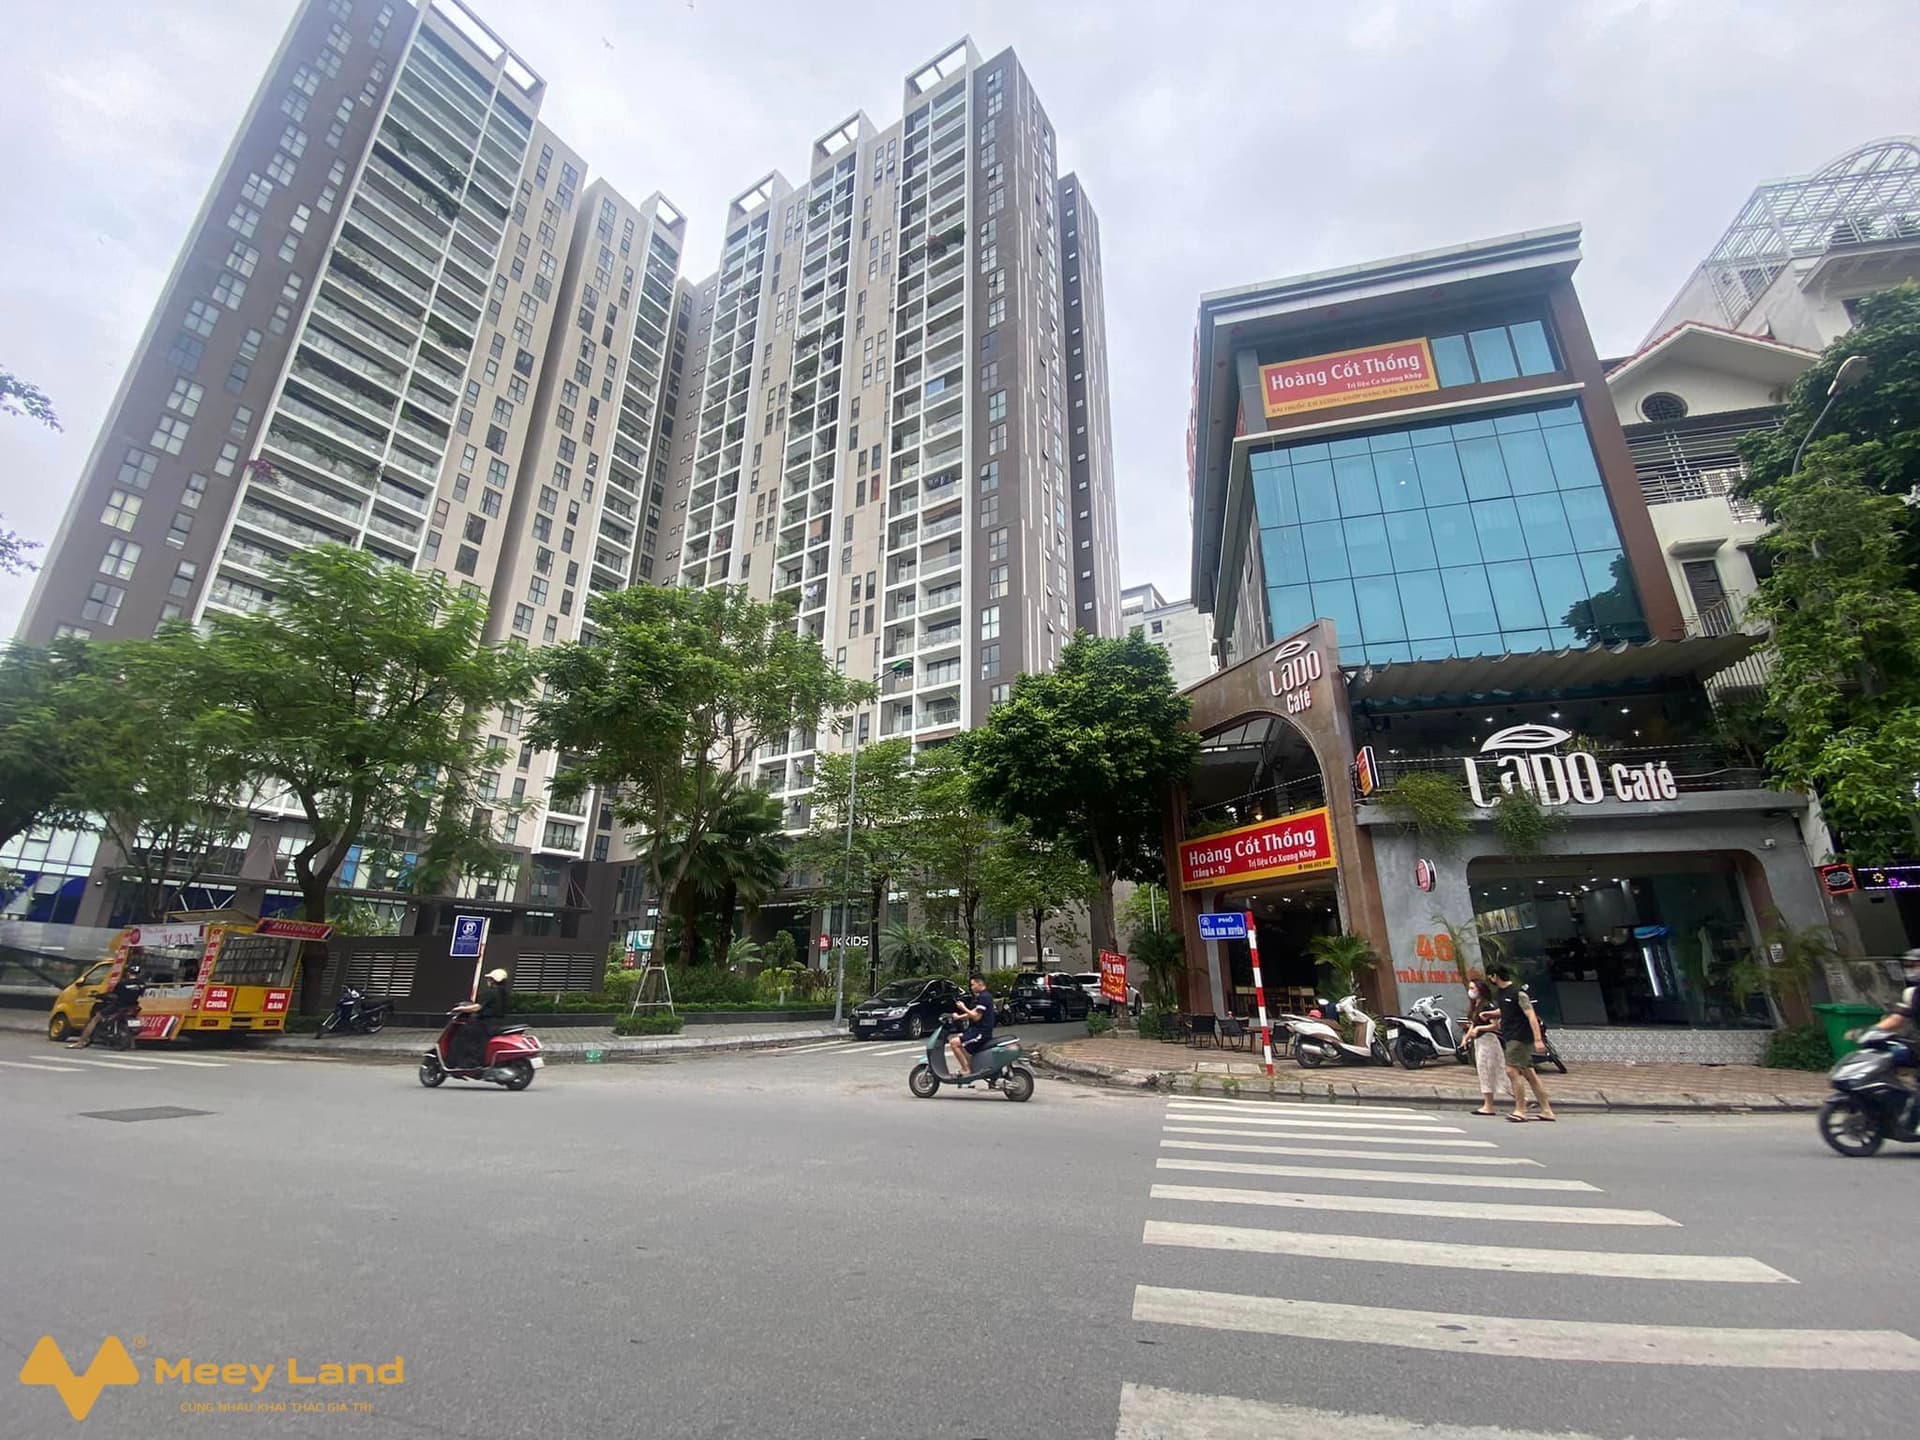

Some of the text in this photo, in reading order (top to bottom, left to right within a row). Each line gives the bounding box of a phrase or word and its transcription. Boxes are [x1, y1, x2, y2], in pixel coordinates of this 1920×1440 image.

[1271, 353, 1420, 390] Hoàng Cốt Thống
[1286, 685, 1312, 714] Café
[1609, 761, 1678, 803] Café
[1189, 827, 1316, 867] Hoàng Cốt Thống
[1218, 915, 1234, 923] PHỐ
[206, 1000, 228, 1009] CHỮA
[211, 990, 228, 998] SỬA
